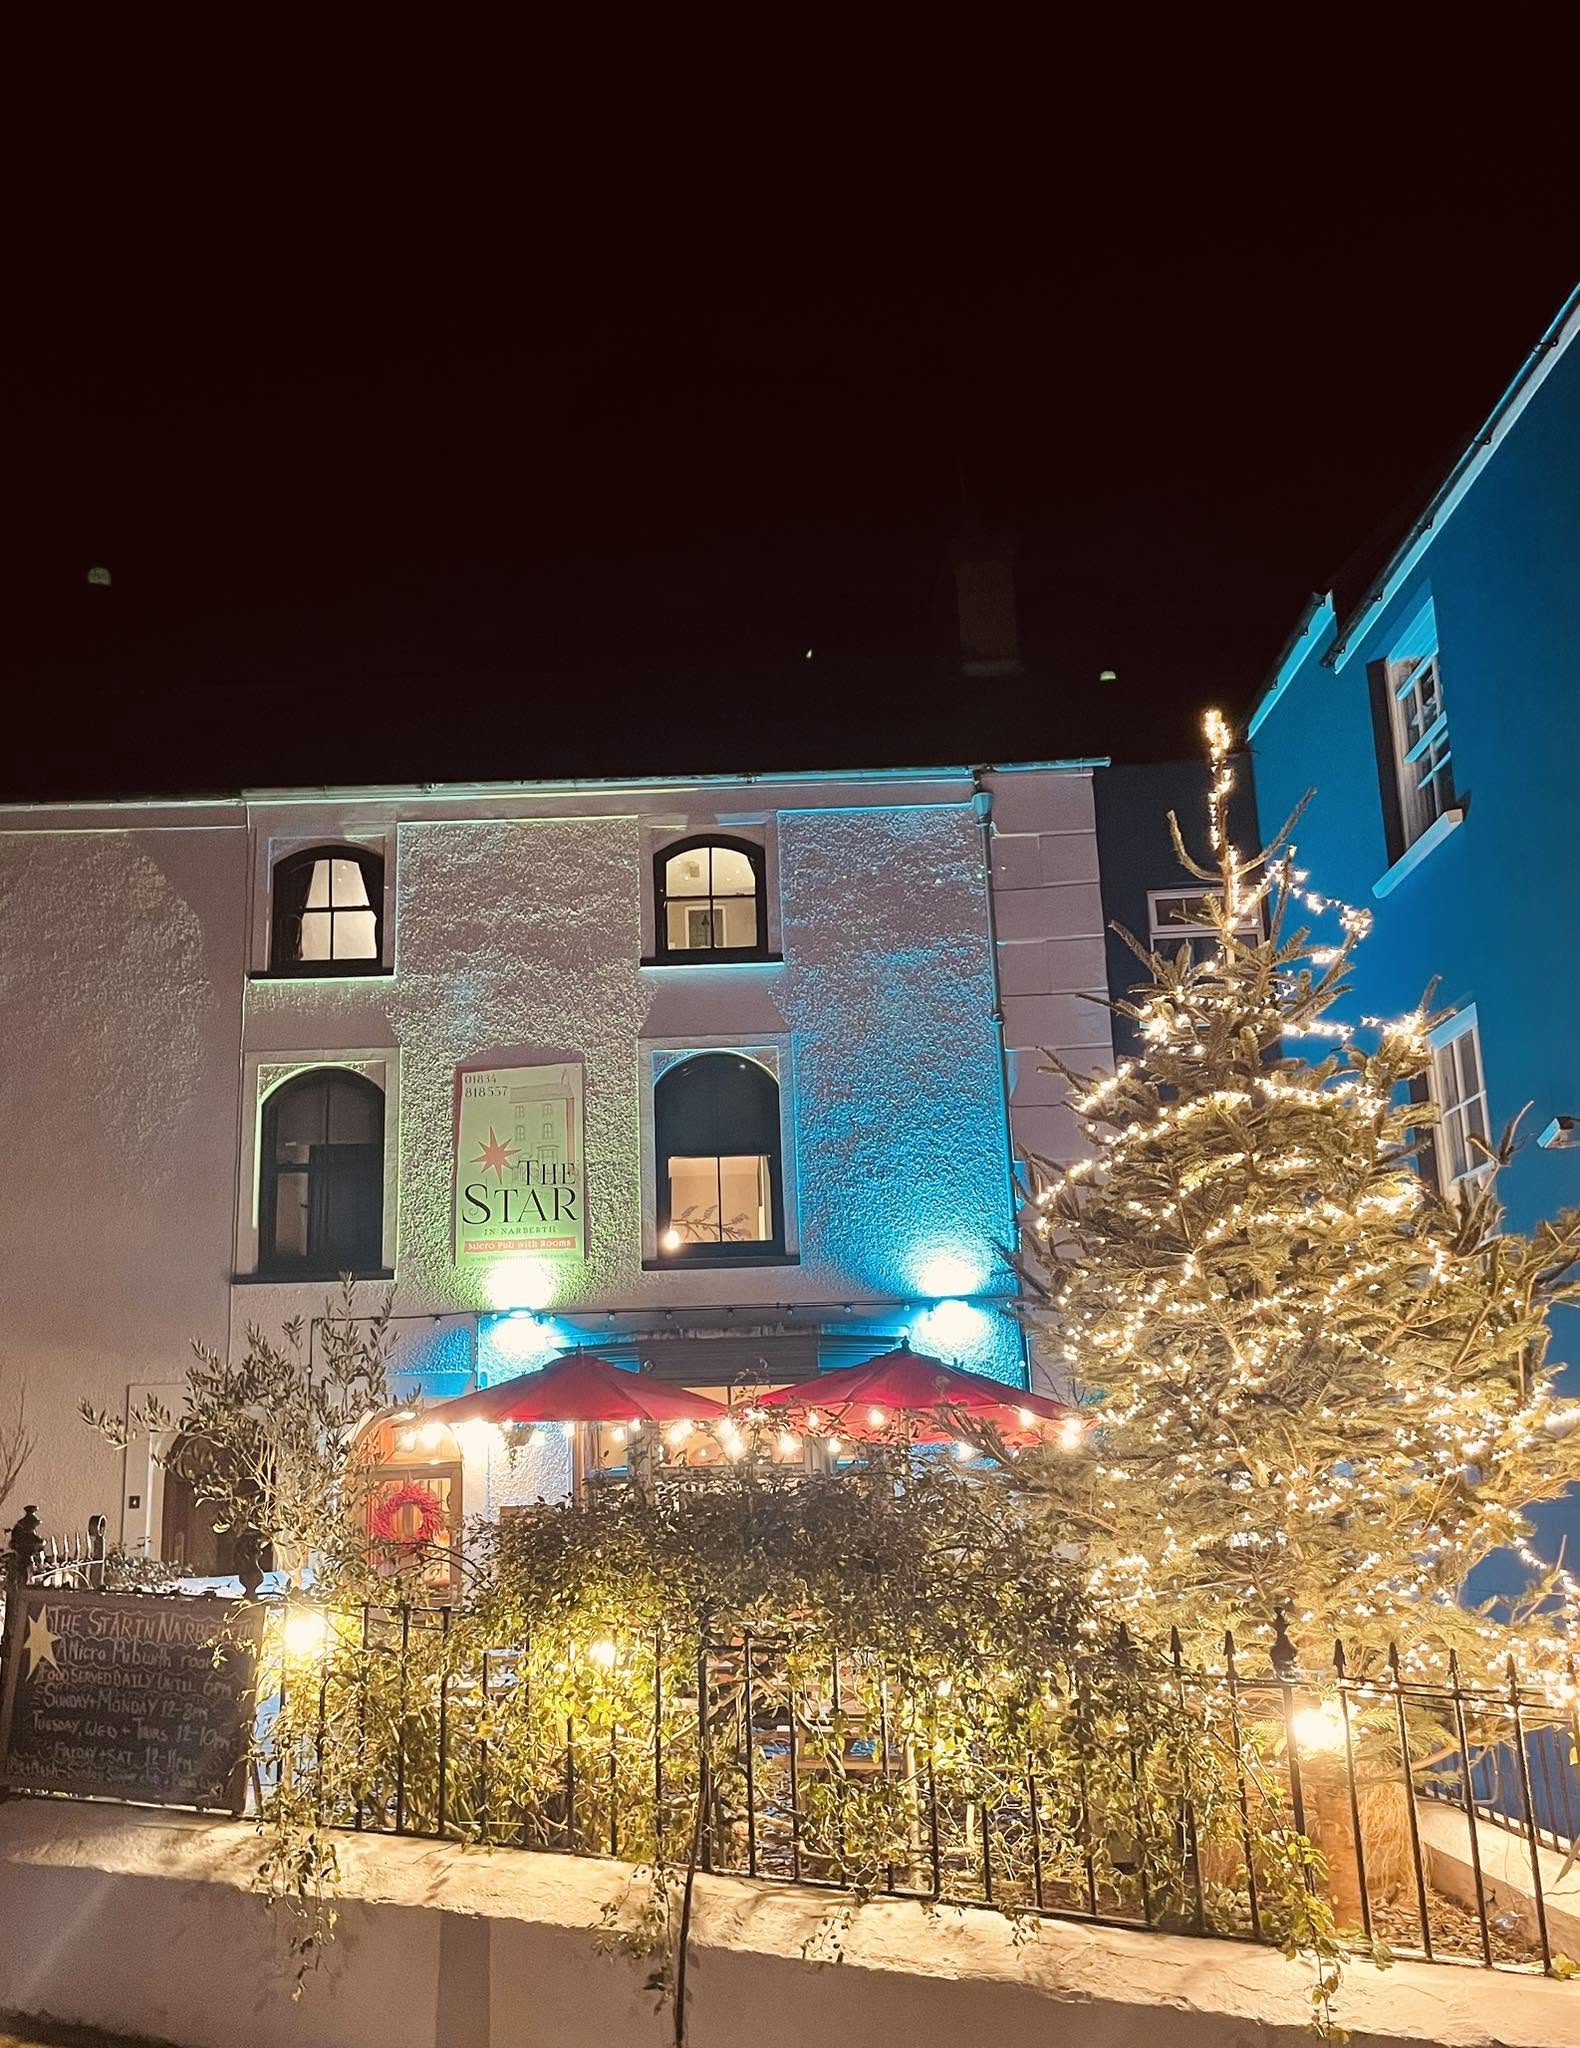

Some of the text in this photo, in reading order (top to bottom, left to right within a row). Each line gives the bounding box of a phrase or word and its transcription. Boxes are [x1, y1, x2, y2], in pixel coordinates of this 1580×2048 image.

[464, 1074, 497, 1084] 01834
[464, 1086, 508, 1098] 818557
[517, 1160, 577, 1186] THE
[462, 1183, 579, 1225] STAR
[484, 1225, 557, 1237] IN NARBERTH
[468, 1242, 496, 1251] Micro
[498, 1241, 515, 1250] Pub
[541, 1238, 571, 1248] Rooms
[51, 1607, 80, 1634] THE
[89, 1609, 132, 1638] STAR
[157, 1612, 252, 1643] NARBEH
[111, 1637, 142, 1665] Pub
[113, 1669, 155, 1689] DAILY
[97, 1689, 160, 1717] MONDAY
